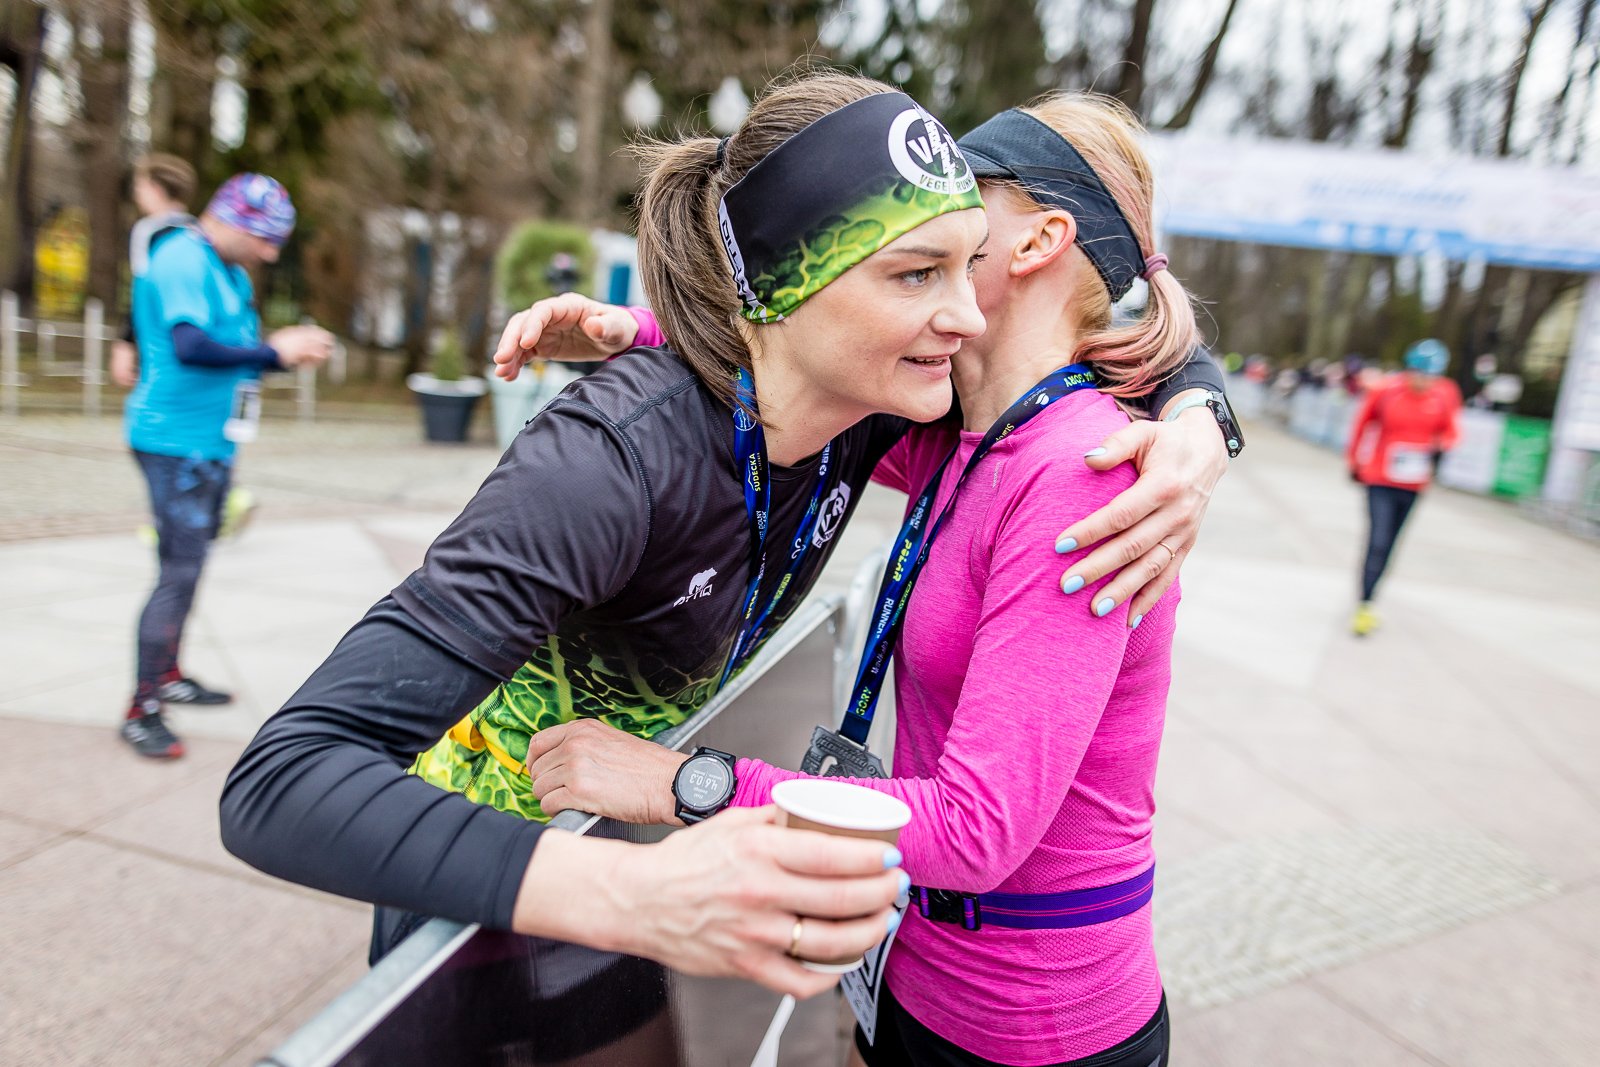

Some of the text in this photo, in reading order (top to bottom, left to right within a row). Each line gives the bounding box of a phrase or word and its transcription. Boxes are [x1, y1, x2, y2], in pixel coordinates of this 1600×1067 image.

[920, 174, 948, 191] VEGE
[749, 453, 761, 492] SUDECKA
[893, 538, 912, 582] POLAR
[690, 774, 703, 786] 0.3
[704, 778, 718, 790] 4.6
